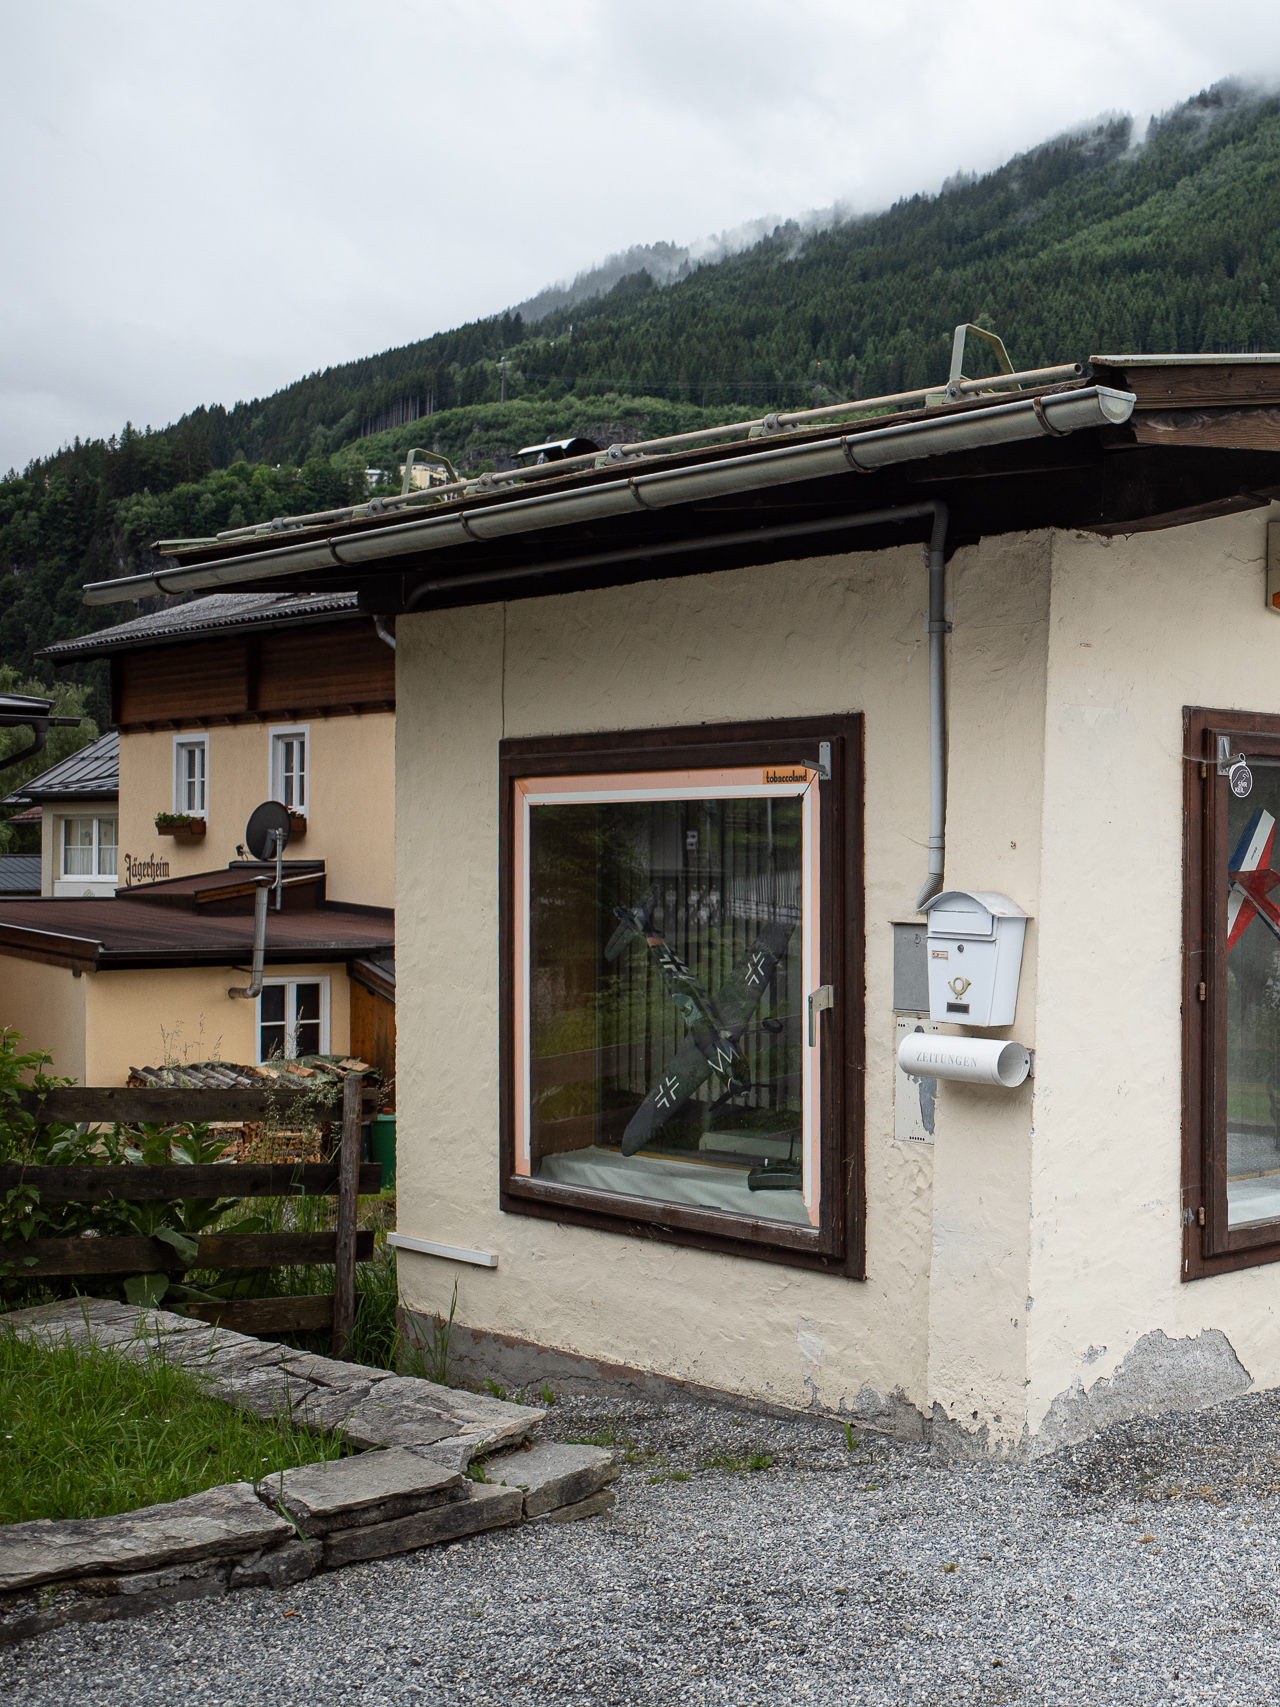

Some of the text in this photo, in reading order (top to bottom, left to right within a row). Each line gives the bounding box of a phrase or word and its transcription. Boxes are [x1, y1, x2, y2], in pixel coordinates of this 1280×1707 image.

[766, 769, 808, 783] tobaccoland
[124, 852, 170, 887] Jägerheim
[916, 1051, 979, 1069] ZEITUNGEN
